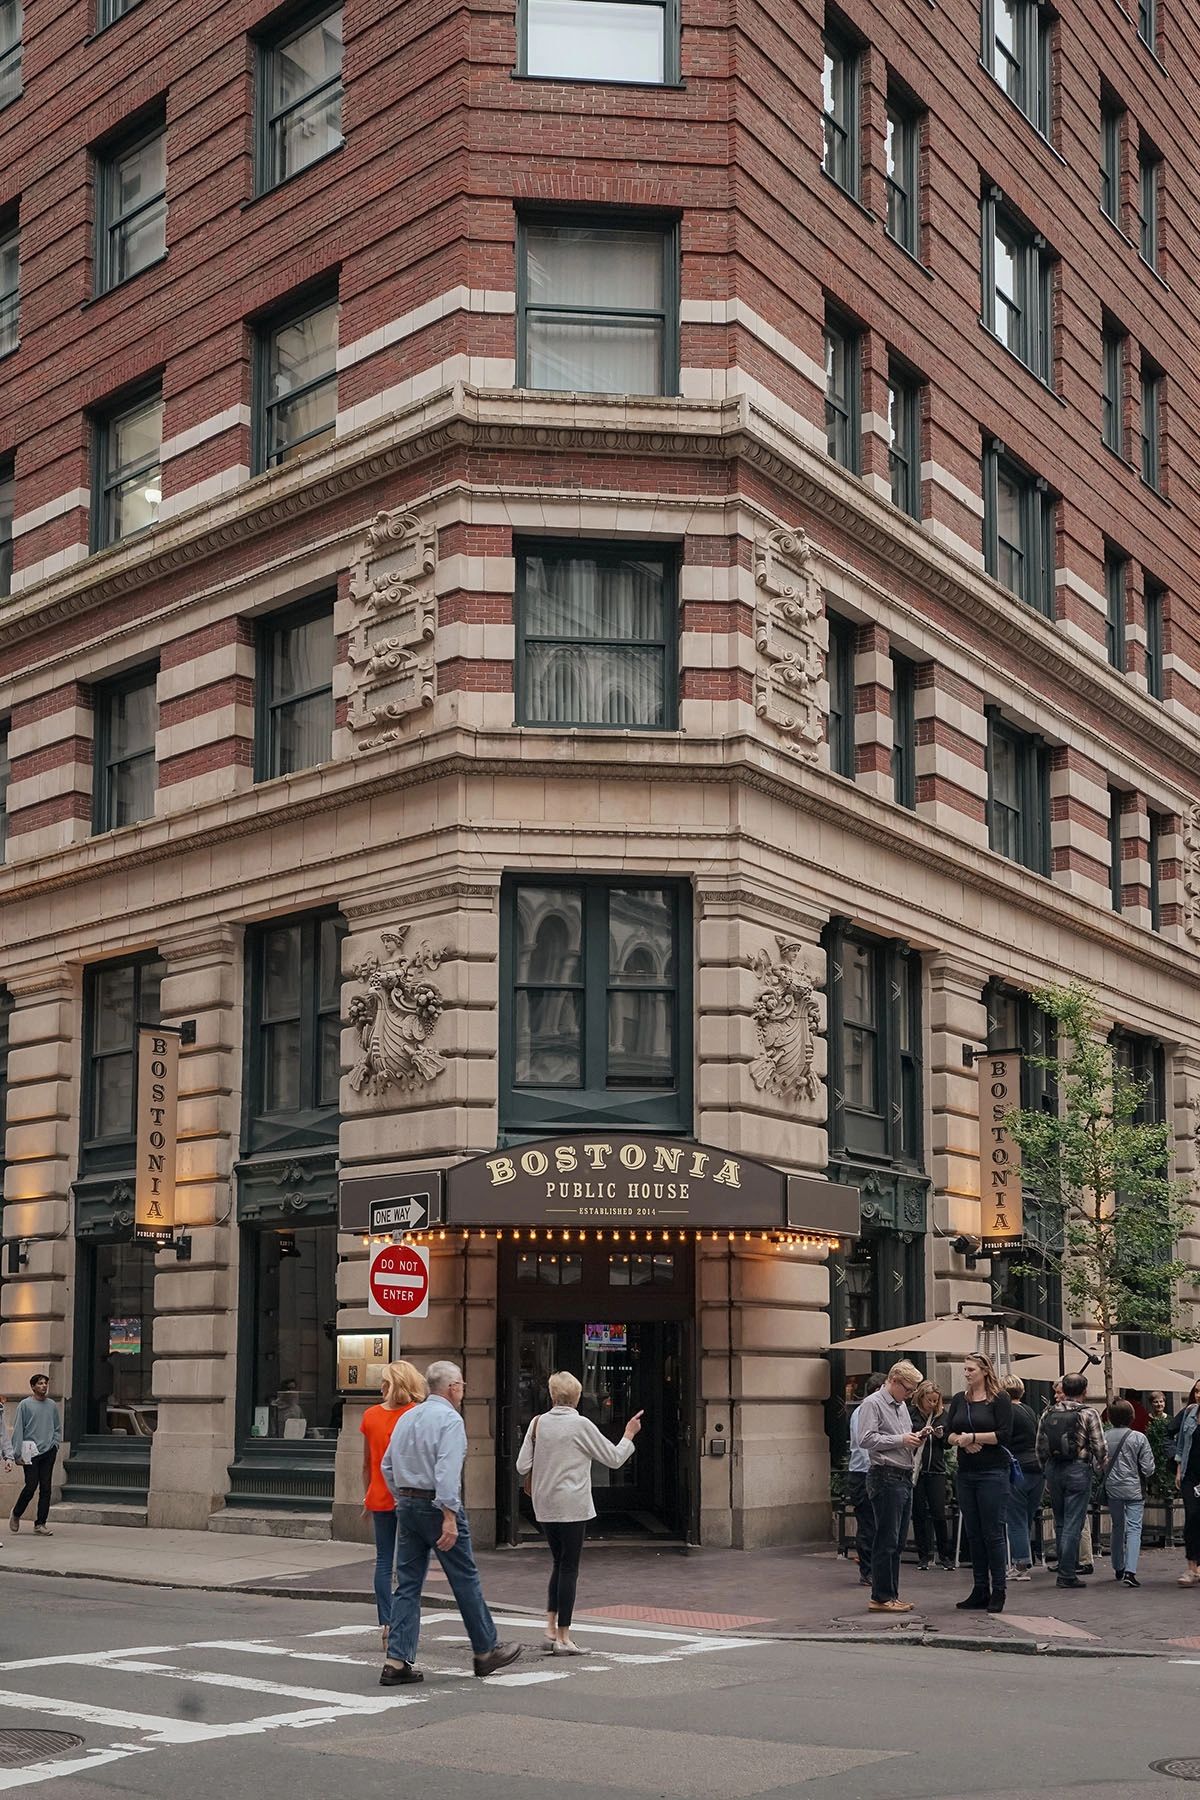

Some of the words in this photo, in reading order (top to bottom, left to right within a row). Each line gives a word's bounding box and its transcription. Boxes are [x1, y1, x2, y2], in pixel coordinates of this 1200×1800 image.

[147, 1037, 167, 1219] BOSTONIA
[991, 1061, 1010, 1230] BOSTONIA
[485, 1144, 742, 1189] BOSTONIA
[545, 1182, 617, 1198] PUBLIC
[627, 1183, 690, 1199] HOUSE
[376, 1210, 391, 1224] ONE
[394, 1207, 410, 1221] WAY
[578, 1207, 633, 1215] ESTABLISHED
[636, 1207, 657, 1215] 2014
[381, 1259, 394, 1269] DO
[399, 1260, 418, 1272] NOT
[383, 1289, 413, 1301] ENTER
